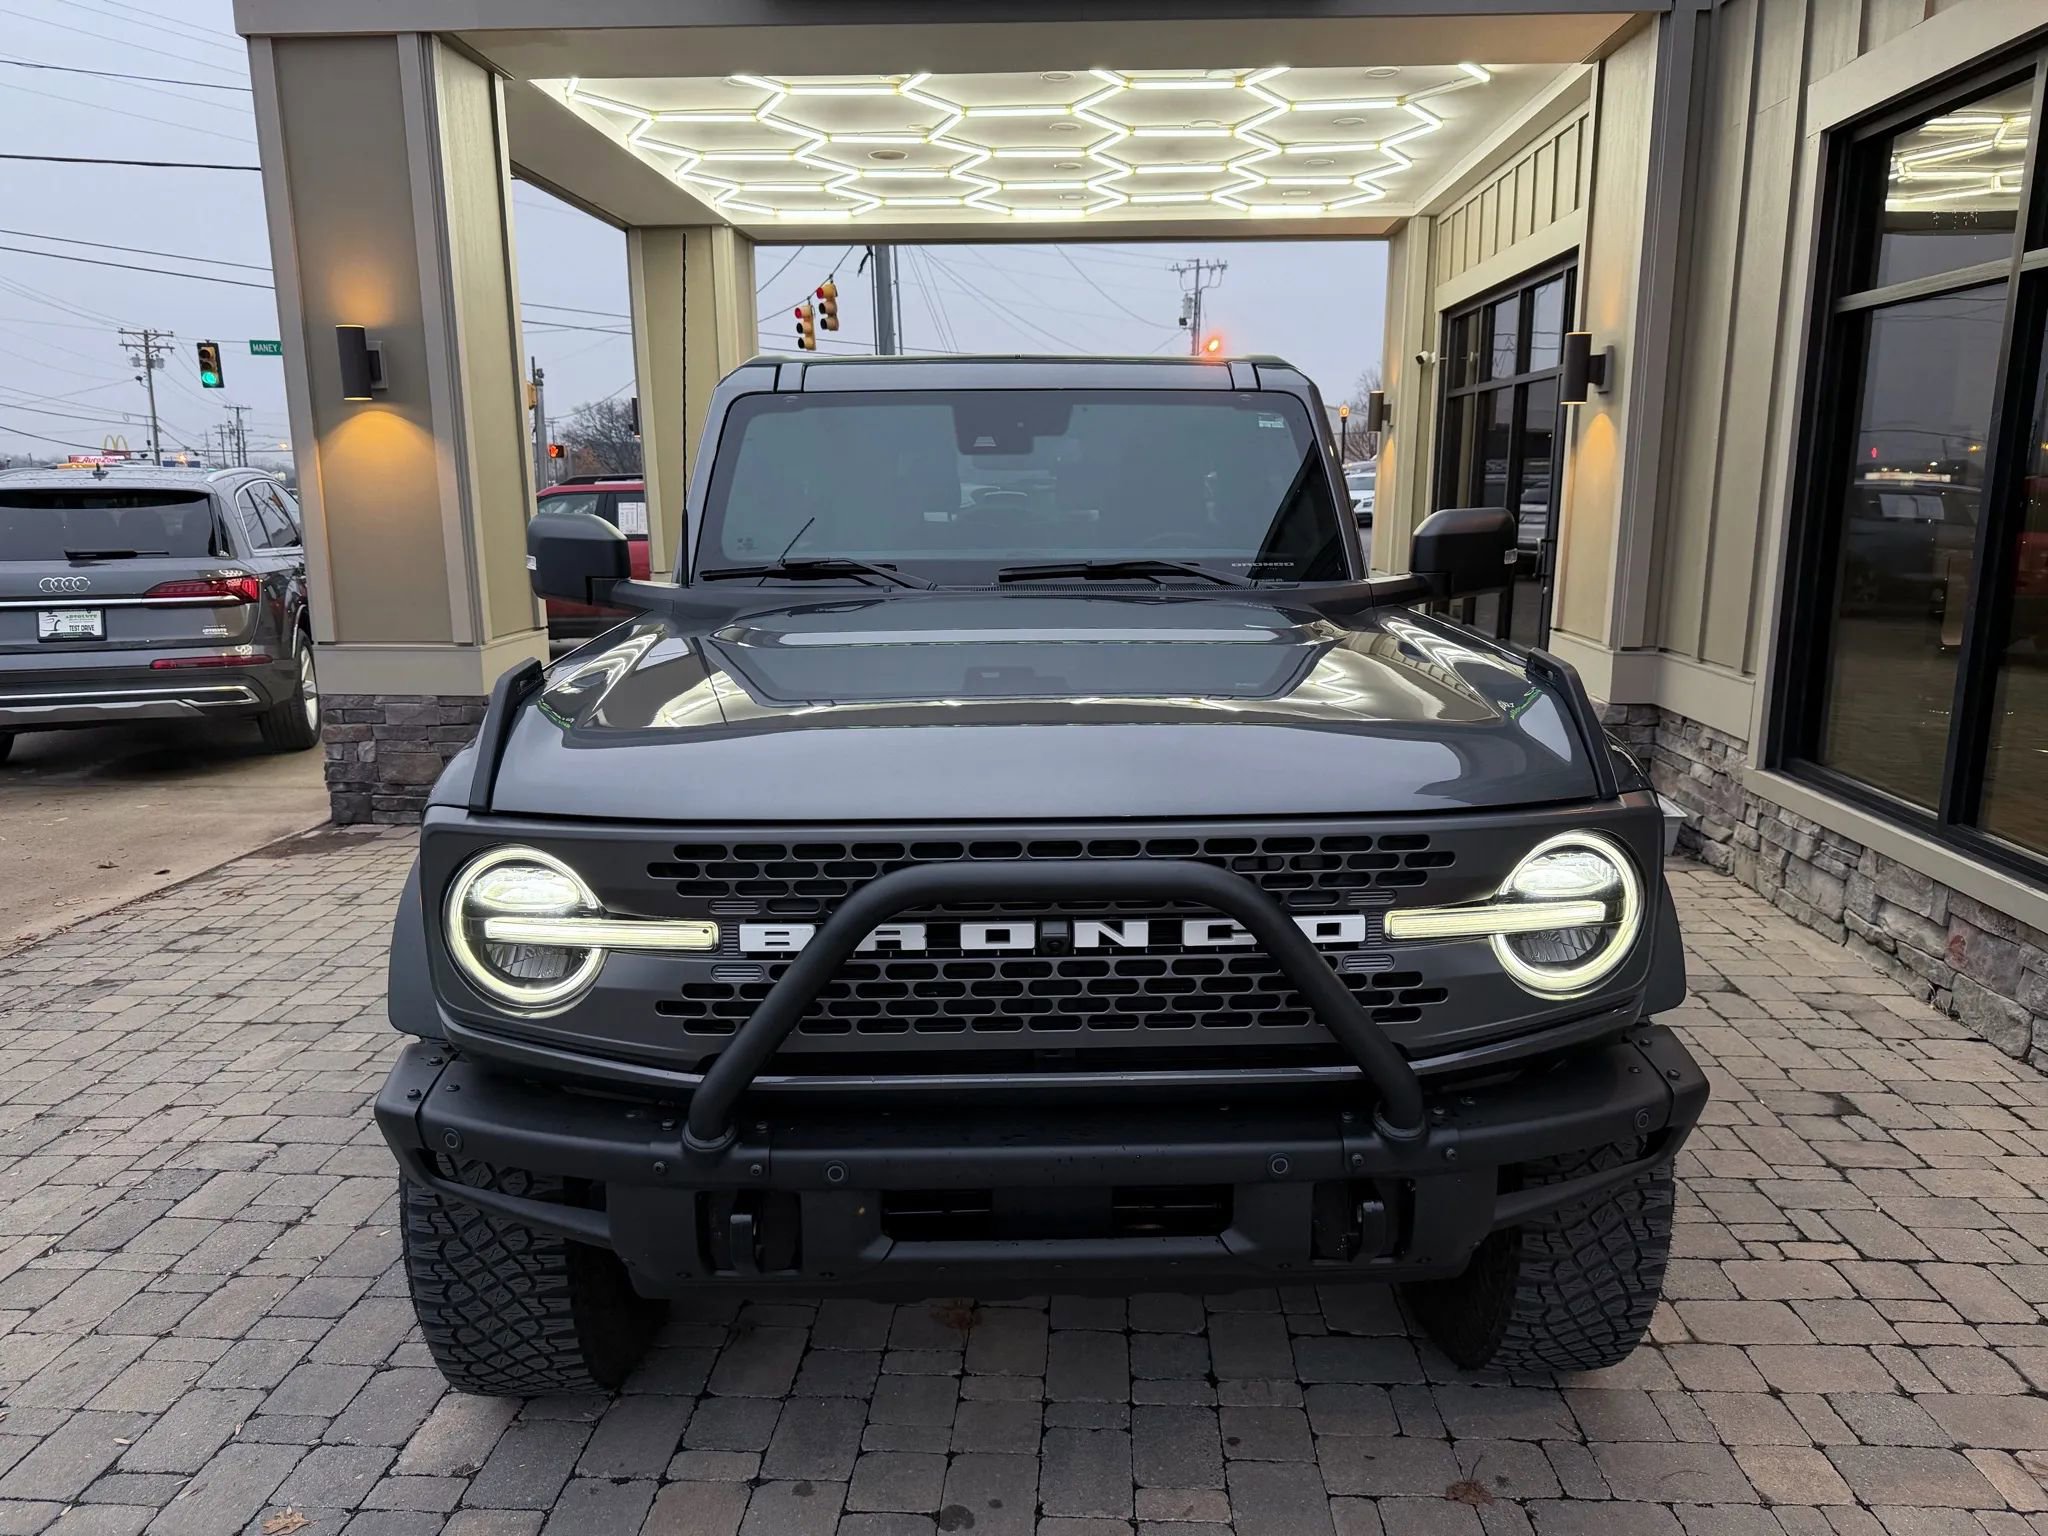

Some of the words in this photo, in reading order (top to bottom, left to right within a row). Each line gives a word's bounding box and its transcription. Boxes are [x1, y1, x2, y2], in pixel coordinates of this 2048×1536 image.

[252, 343, 278, 352] MANEY
[69, 624, 80, 632] TEST
[80, 624, 95, 632] DRIVE
[739, 914, 1366, 951] BRONCO
